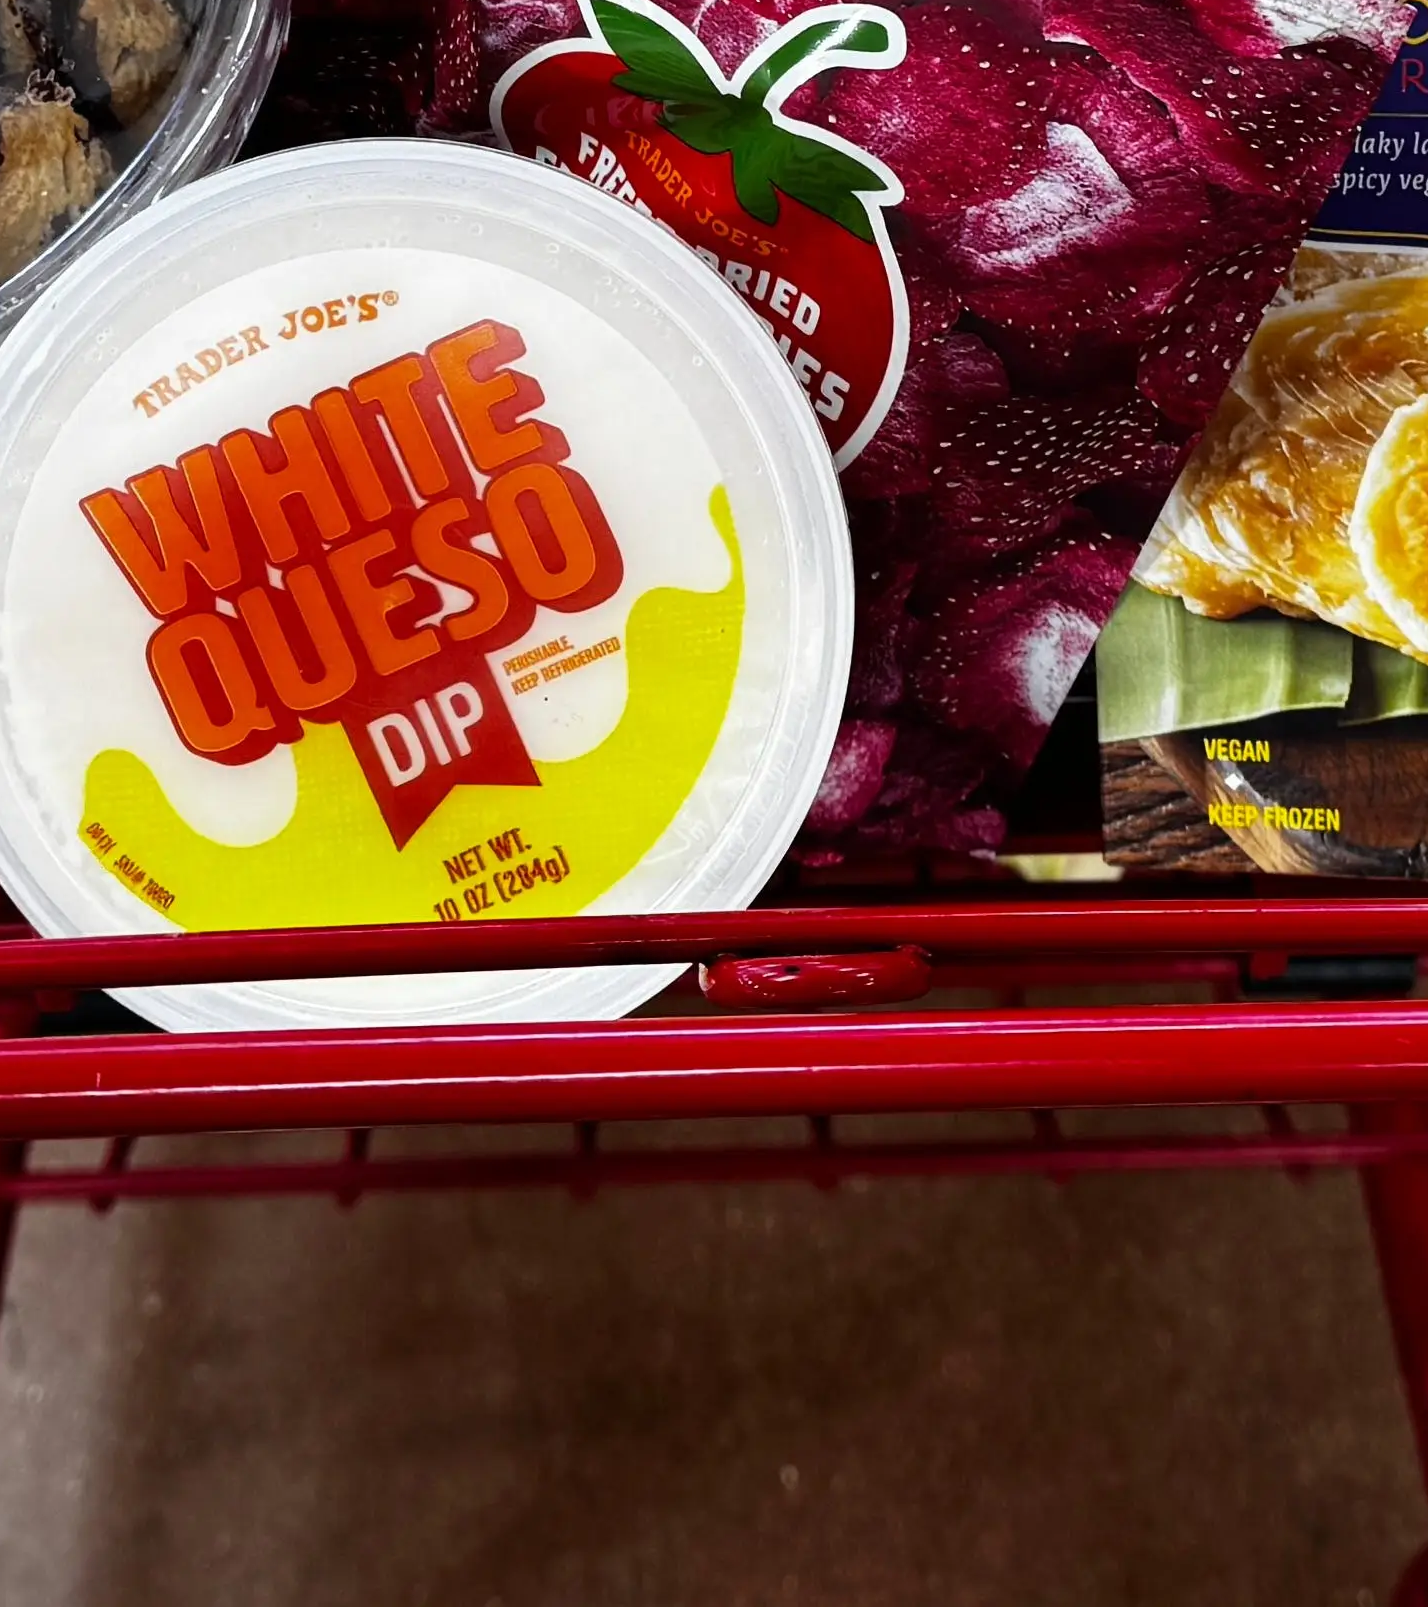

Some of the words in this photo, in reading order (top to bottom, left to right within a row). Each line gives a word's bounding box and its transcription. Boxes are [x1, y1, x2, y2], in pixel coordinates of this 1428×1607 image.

[624, 130, 694, 207] TRADER
[1352, 131, 1404, 163] laky
[1332, 167, 1392, 196] spicy
[132, 325, 270, 418] TRADER
[80, 320, 570, 618] WHITE
[147, 464, 622, 763] QUESO
[502, 635, 575, 676] PERISHABLE,
[511, 672, 539, 695] KEEP
[540, 636, 621, 682] REFRIGERATED
[367, 681, 486, 788] DIP
[1204, 737, 1271, 763] VEGAN
[1208, 803, 1259, 828] KEEP
[1262, 804, 1340, 831] FROZEN
[433, 897, 461, 921] 10
[463, 882, 494, 924] OZ
[493, 845, 570, 903] (284g)
[442, 845, 486, 884] NET
[487, 827, 532, 862] WT.
